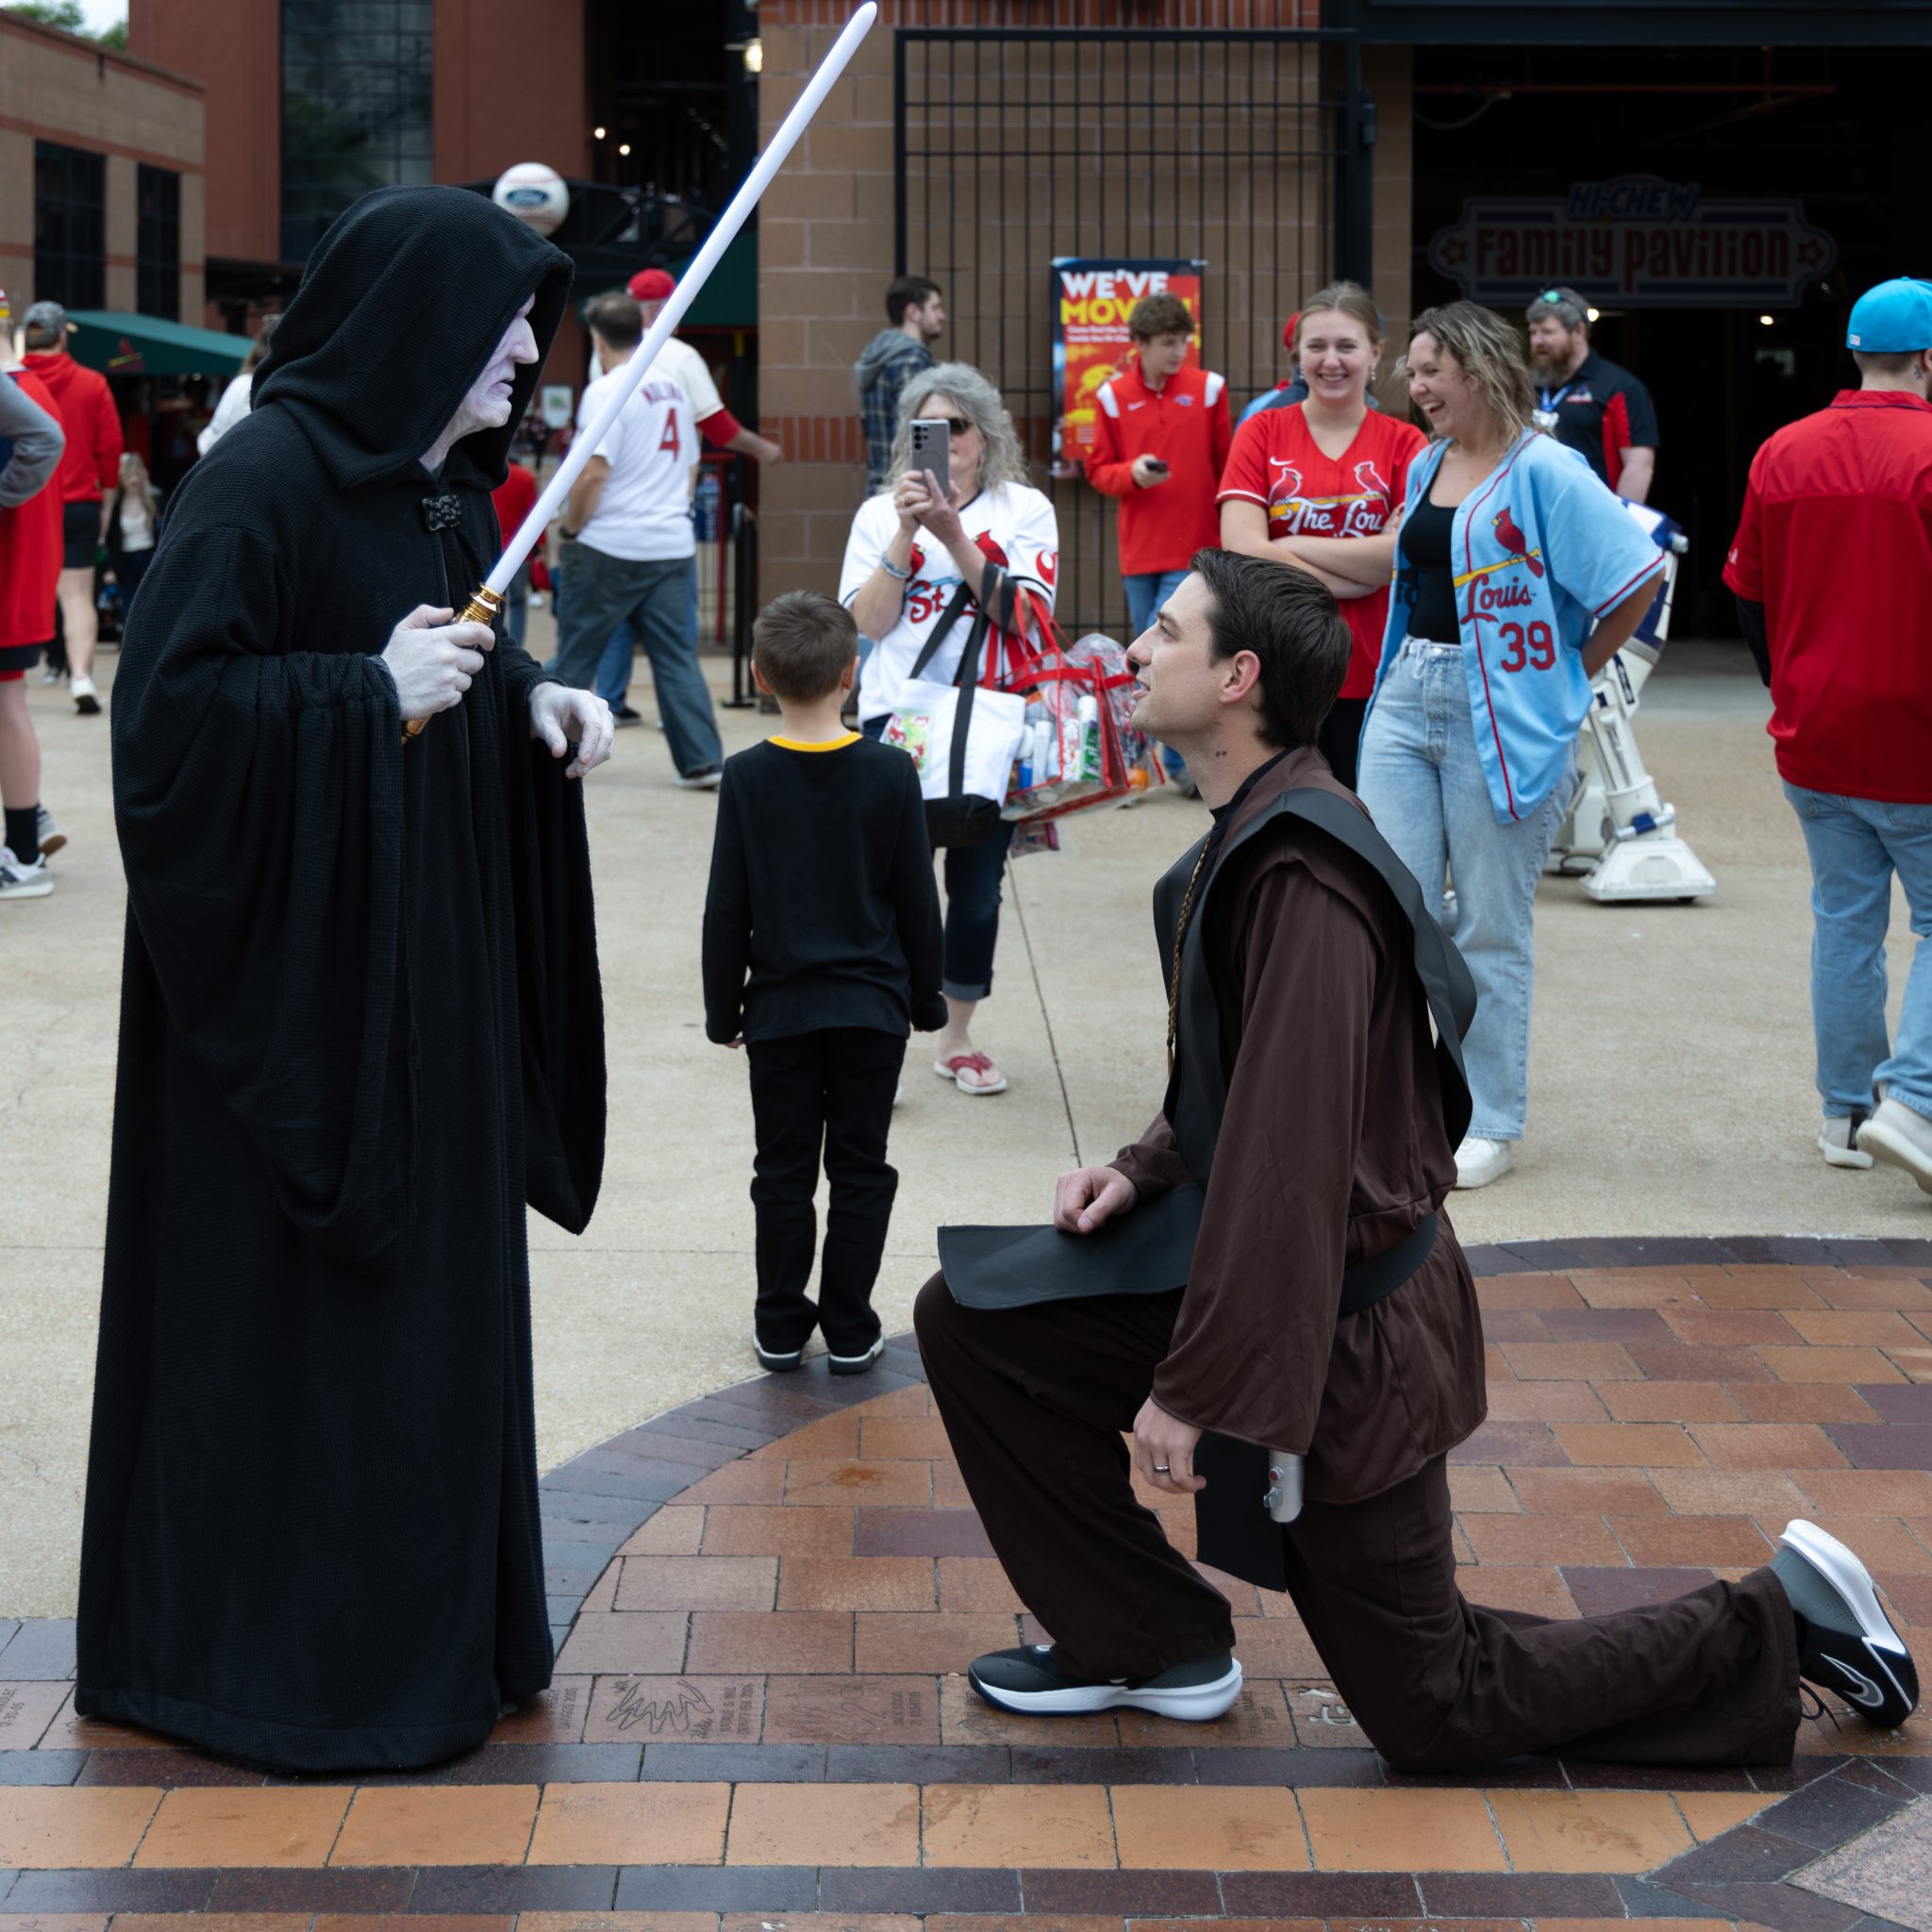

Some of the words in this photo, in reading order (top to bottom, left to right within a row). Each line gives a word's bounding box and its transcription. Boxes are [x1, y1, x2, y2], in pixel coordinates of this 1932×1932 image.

[1475, 227, 1613, 283] Family
[1059, 269, 1169, 298] WE'VE
[658, 407, 680, 463] 4
[1280, 496, 1339, 536] The
[1339, 498, 1383, 539] Lou
[1460, 573, 1532, 625] Louis
[1499, 620, 1556, 674] 39
